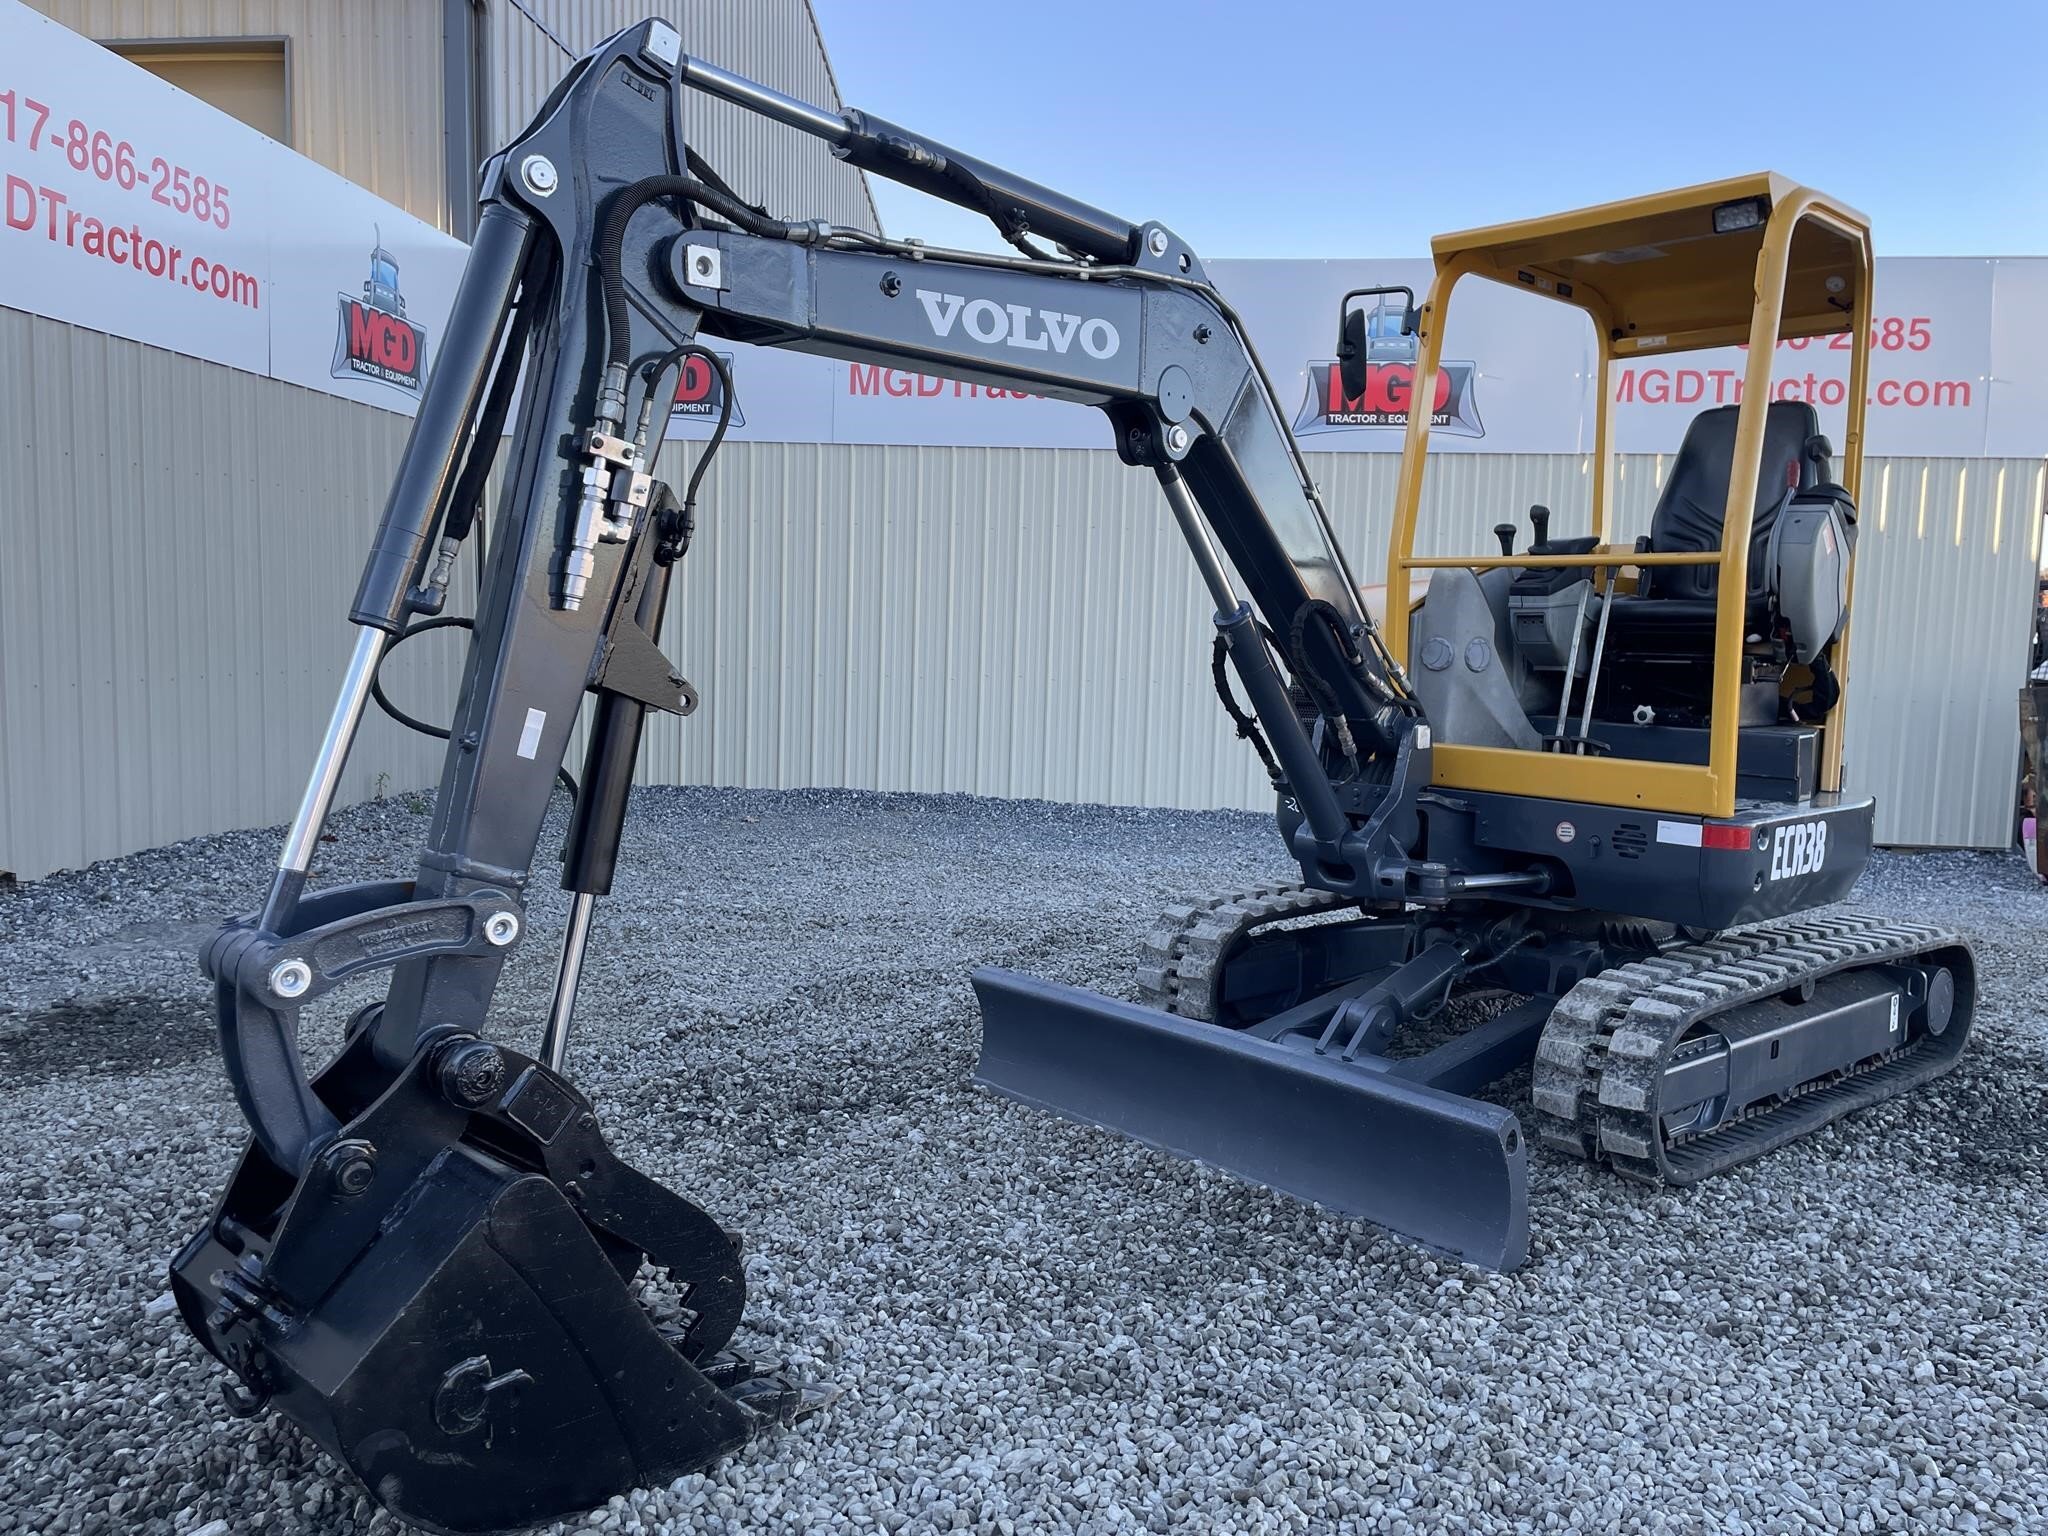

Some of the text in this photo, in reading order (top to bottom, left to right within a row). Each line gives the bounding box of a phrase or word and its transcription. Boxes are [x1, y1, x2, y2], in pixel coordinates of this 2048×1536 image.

[6, 172, 260, 309] DTractor.com
[351, 300, 416, 374] MGD
[915, 288, 1120, 360] VOLVO
[352, 358, 380, 376] TRACTOR
[385, 369, 417, 388] EQUIPMENT
[1615, 368, 1971, 406] MGDTrcto.com
[1328, 413, 1449, 425] TRACTOR & EQUENT
[1769, 820, 1827, 881] ECR38
